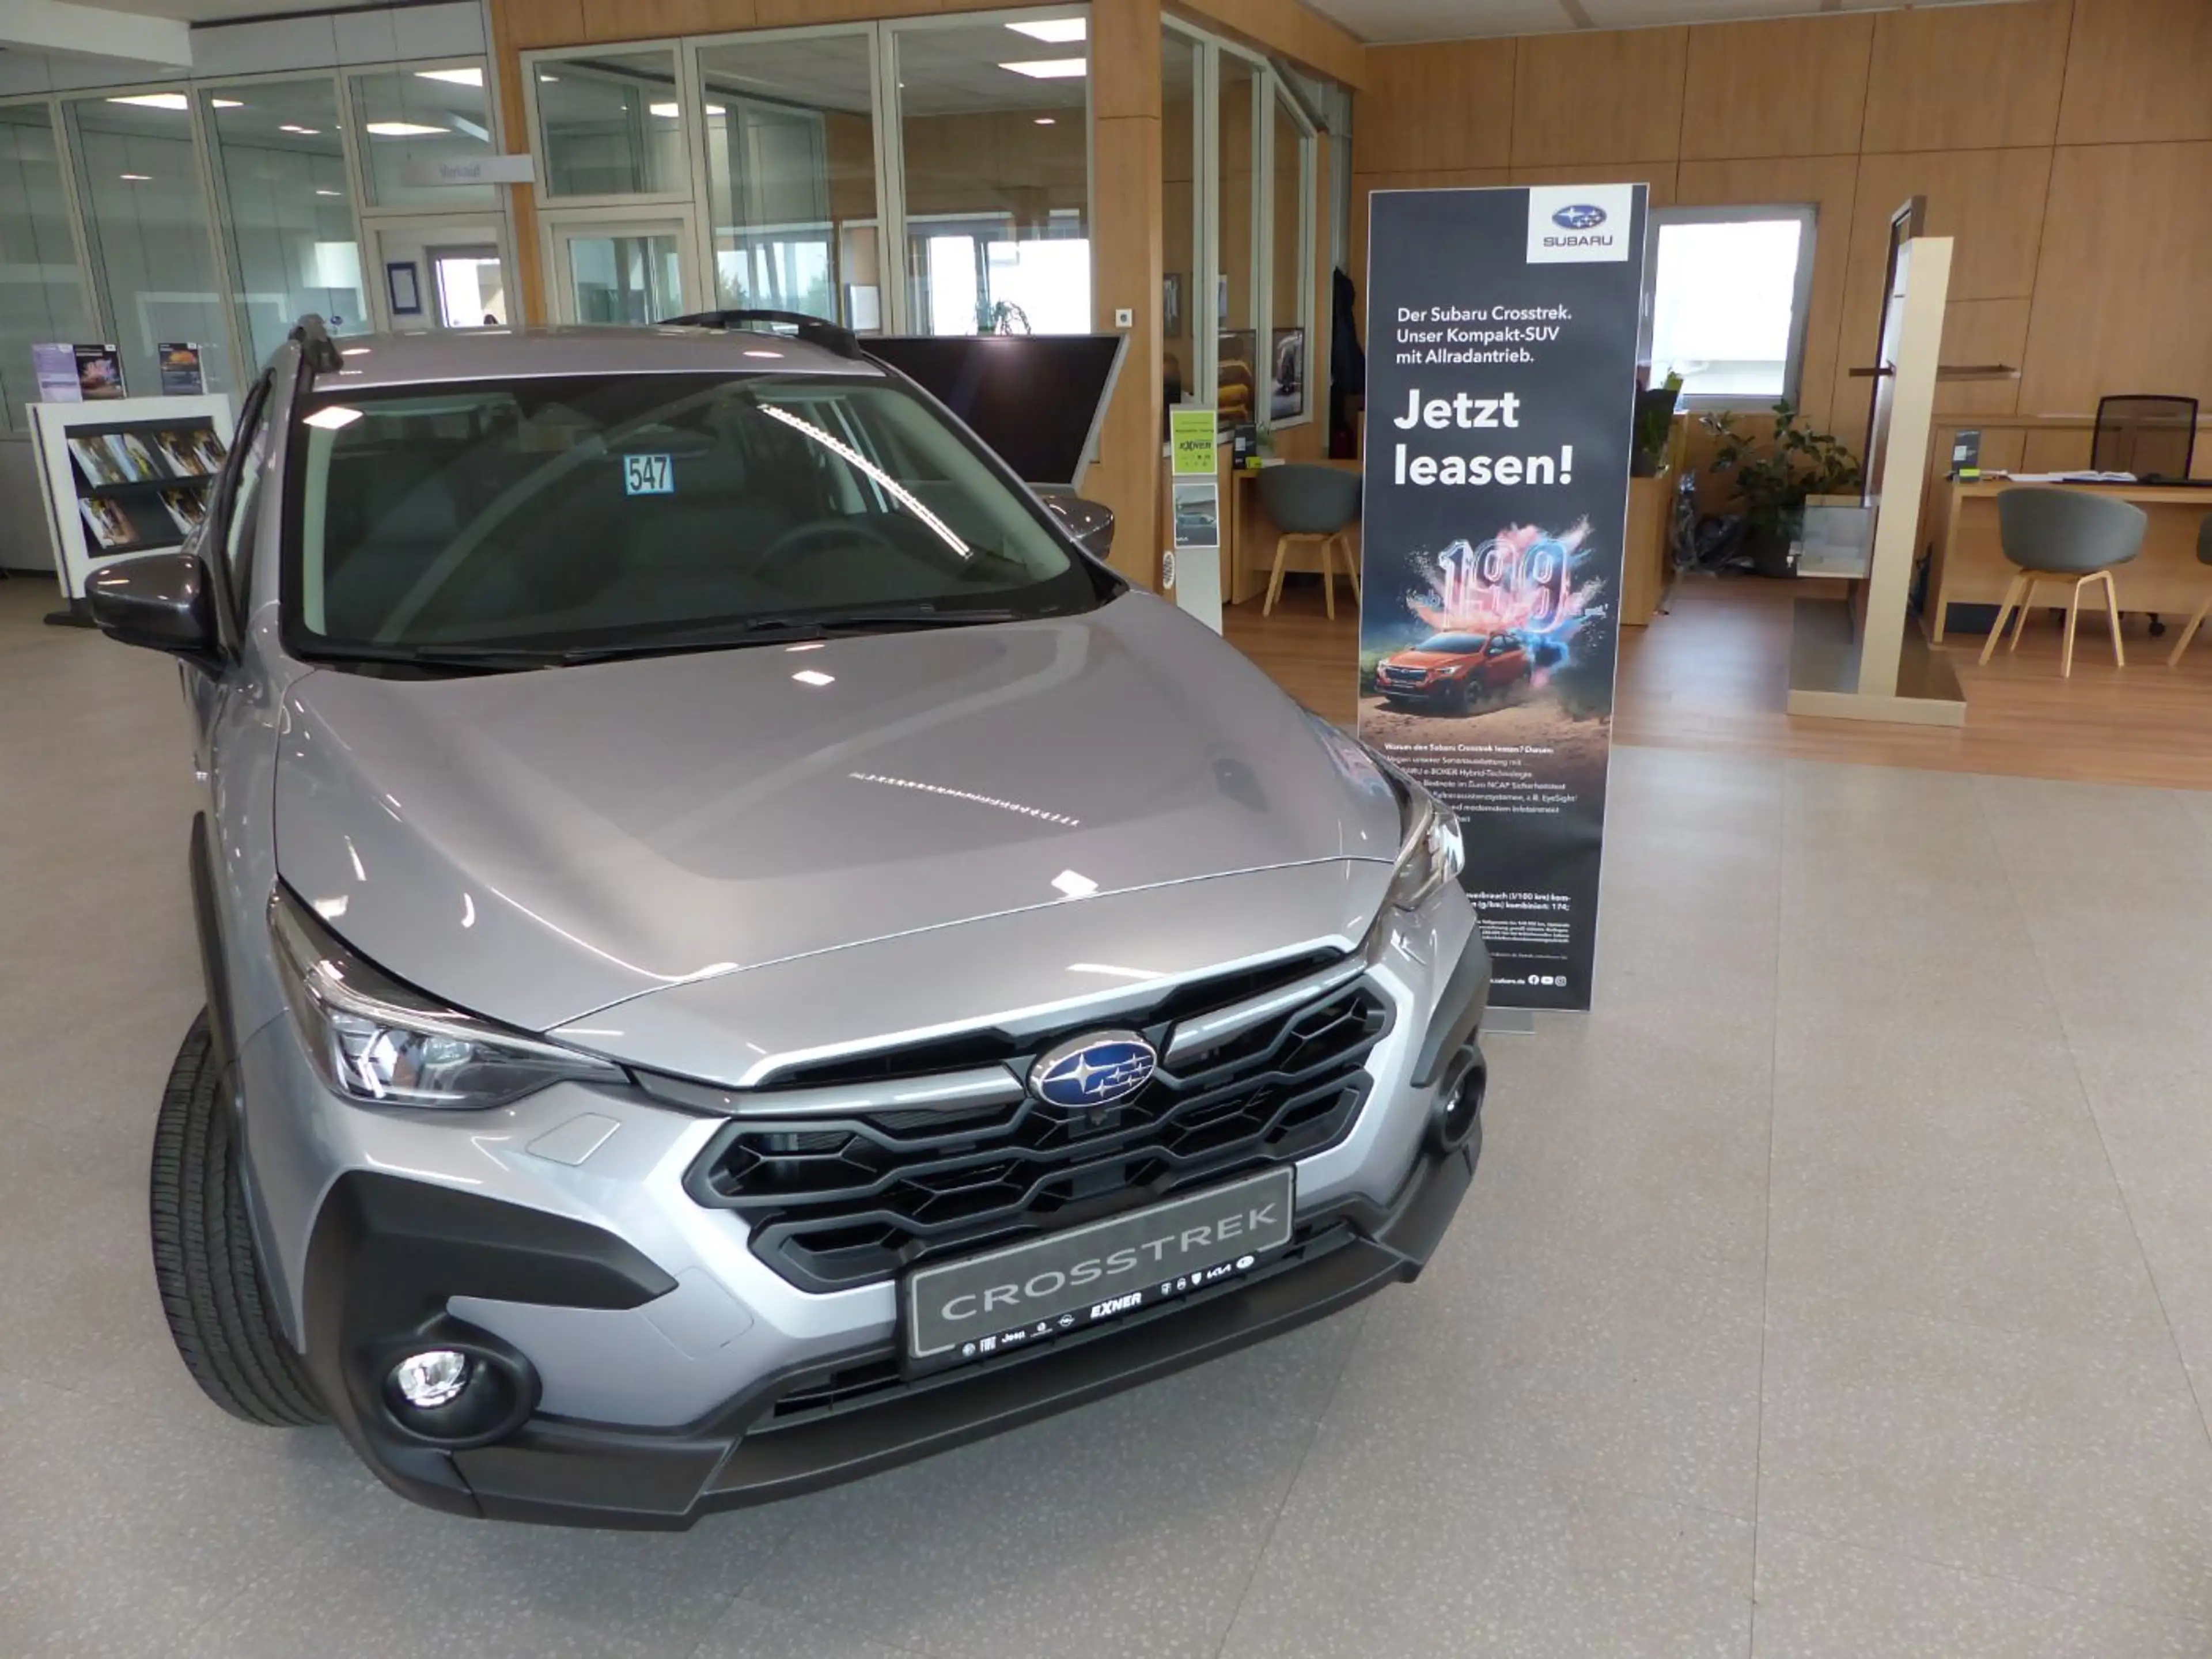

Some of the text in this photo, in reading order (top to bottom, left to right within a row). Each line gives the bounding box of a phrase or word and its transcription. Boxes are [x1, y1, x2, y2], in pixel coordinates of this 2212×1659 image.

[1543, 235, 1612, 247] SUBARU
[1397, 304, 1572, 322] Der Subaru Crosstrek.
[1397, 326, 1560, 346] Unser Kompakt-SUV
[1396, 347, 1534, 364] mit Allradantrieb.
[1393, 389, 1520, 430] Jetzt
[630, 457, 668, 491] 547
[1395, 444, 1574, 485] leasen!
[1438, 539, 1571, 632] 199
[940, 1202, 1278, 1320] CROSSTREK
[1001, 1331, 1026, 1343] Jeep
[1090, 1291, 1142, 1320] EXNER
